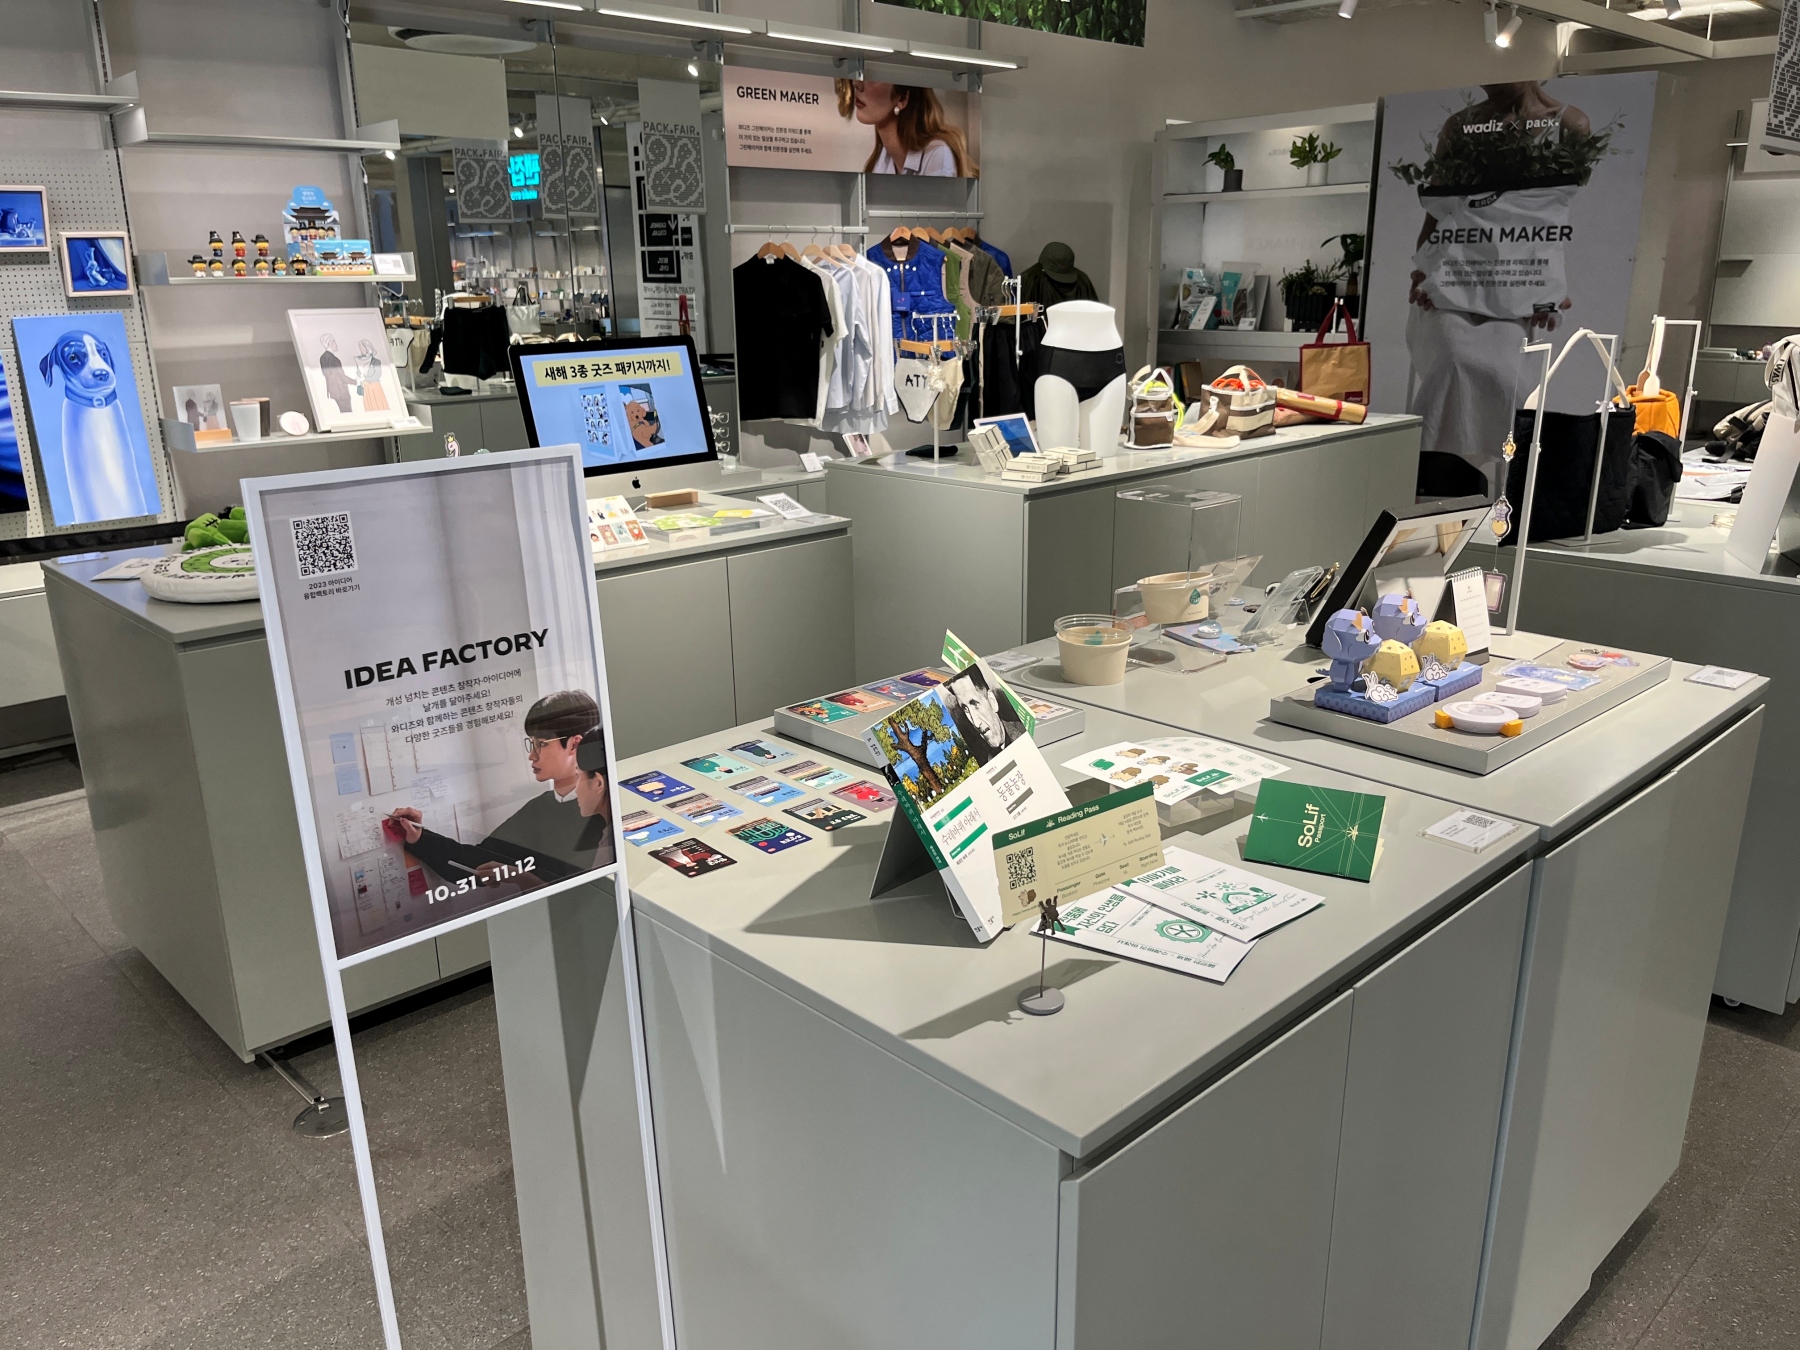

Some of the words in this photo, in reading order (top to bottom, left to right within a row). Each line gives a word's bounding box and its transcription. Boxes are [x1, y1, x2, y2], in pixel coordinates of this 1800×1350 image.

[737, 86, 776, 102] GREEN
[780, 90, 819, 105] MAKER
[643, 122, 700, 136] PACK.FAIR.
[1462, 119, 1504, 134] wadiz
[1526, 118, 1560, 130] pack.
[540, 134, 592, 146] PAC.FAIR.
[1427, 228, 1493, 245] GREEN
[1499, 226, 1573, 243] MAKER
[545, 366, 568, 380] 새해
[570, 365, 588, 378] 3종
[591, 364, 613, 376] 굿즈
[615, 359, 671, 375] 패키지까지!
[1772, 364, 1782, 383] WAS
[309, 581, 327, 590] 2023
[328, 577, 352, 586] 아이디어
[336, 584, 360, 593] 바로가기
[344, 656, 417, 689] IDEA
[422, 628, 548, 672] FACTORY
[386, 694, 402, 707] 개성
[404, 690, 429, 703] 넘치는
[432, 684, 456, 697] 콘텐츠
[422, 699, 447, 713] 날개를
[449, 689, 491, 708] 달아주세요!
[391, 719, 424, 734] 와디즈와
[426, 712, 458, 726] 함께하는
[460, 704, 484, 718] 콘텐츠
[486, 694, 523, 711] 창작자들의
[405, 731, 430, 744] 다양한
[432, 722, 463, 737] 굿즈들을
[466, 710, 514, 730] 경험해보세요!
[996, 770, 1026, 802] 동물농장
[942, 821, 966, 846] 수레바퀴
[965, 807, 982, 827] 아래서
[1008, 829, 1025, 840] SoLif
[1057, 810, 1084, 824] Reading
[1084, 805, 1099, 816] Pass
[1298, 803, 1320, 848] SoLif
[1314, 814, 1326, 843] Passport
[426, 876, 476, 904] 10.31
[493, 856, 536, 881] 11.12
[1057, 881, 1081, 893] Passenger
[1095, 871, 1106, 879] Gate
[1139, 852, 1158, 862] Boarding
[1076, 908, 1104, 929] 자신의
[1098, 893, 1126, 913] 인생을
[1095, 920, 1120, 934] 담다
